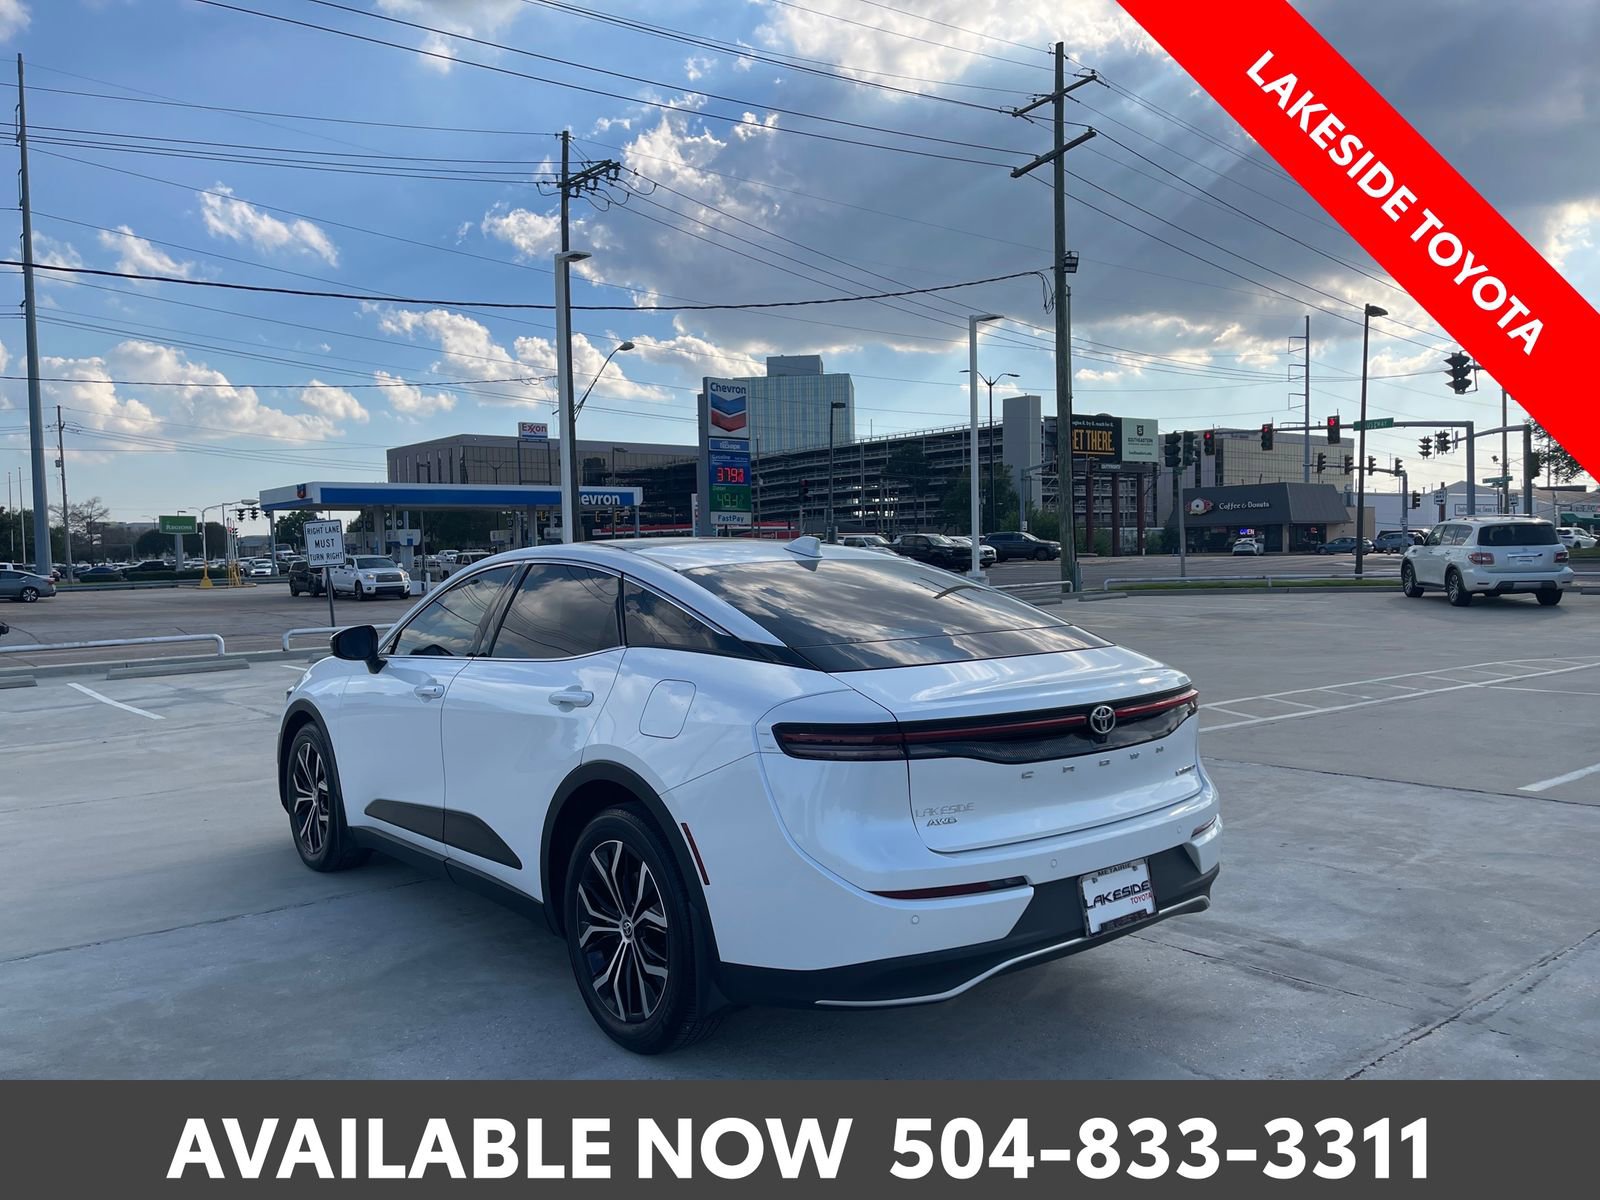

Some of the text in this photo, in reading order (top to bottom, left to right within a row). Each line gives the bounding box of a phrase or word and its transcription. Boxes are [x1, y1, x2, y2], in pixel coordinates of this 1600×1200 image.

[710, 382, 747, 394] Chevron
[522, 423, 547, 434] Exxon
[1072, 429, 1115, 452] ET THERE.
[578, 494, 620, 505] evron
[1219, 502, 1240, 510] Coffee
[718, 515, 744, 523] FastPay
[307, 525, 340, 535] RIGHT LANE
[315, 538, 335, 548] MUST
[310, 551, 342, 561] TURN RIGHT
[915, 802, 975, 818] LAKESIDE
[1085, 880, 1150, 909] LAKESIDE
[1130, 891, 1153, 905] TOYOTA
